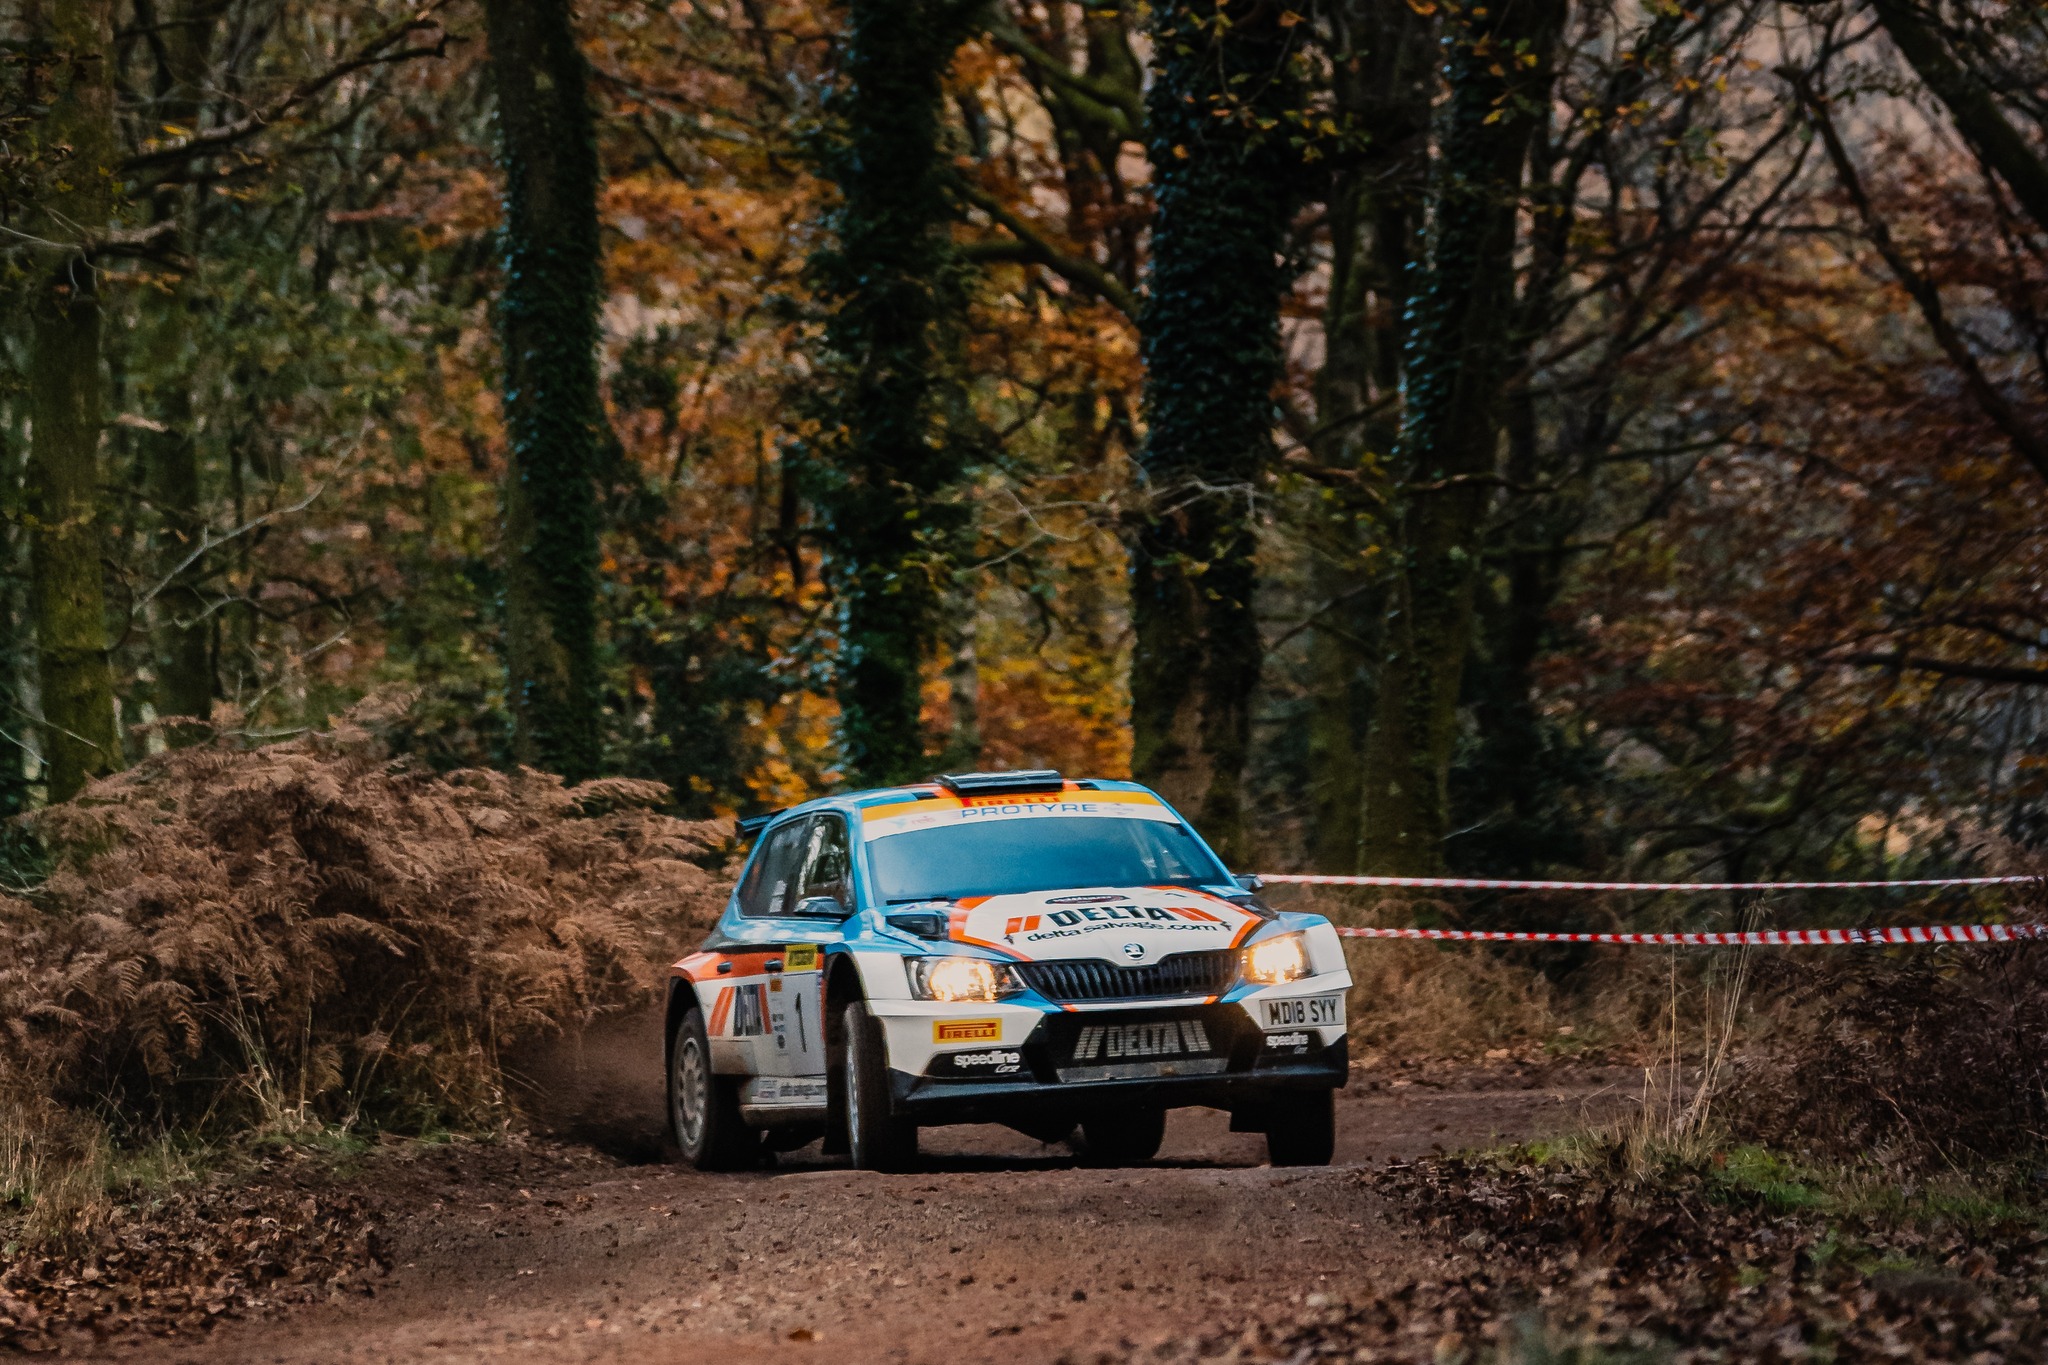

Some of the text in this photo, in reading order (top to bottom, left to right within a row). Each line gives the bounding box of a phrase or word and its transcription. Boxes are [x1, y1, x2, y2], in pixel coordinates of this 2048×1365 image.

[962, 803, 1099, 818] PROTYRE
[1046, 905, 1178, 927] DELTA
[796, 992, 807, 1053] 1
[1268, 999, 1336, 1025] MD18 SYY
[938, 1022, 997, 1040] PIRELLI
[1106, 1021, 1182, 1057] DELTA
[953, 1050, 1020, 1068] speedline
